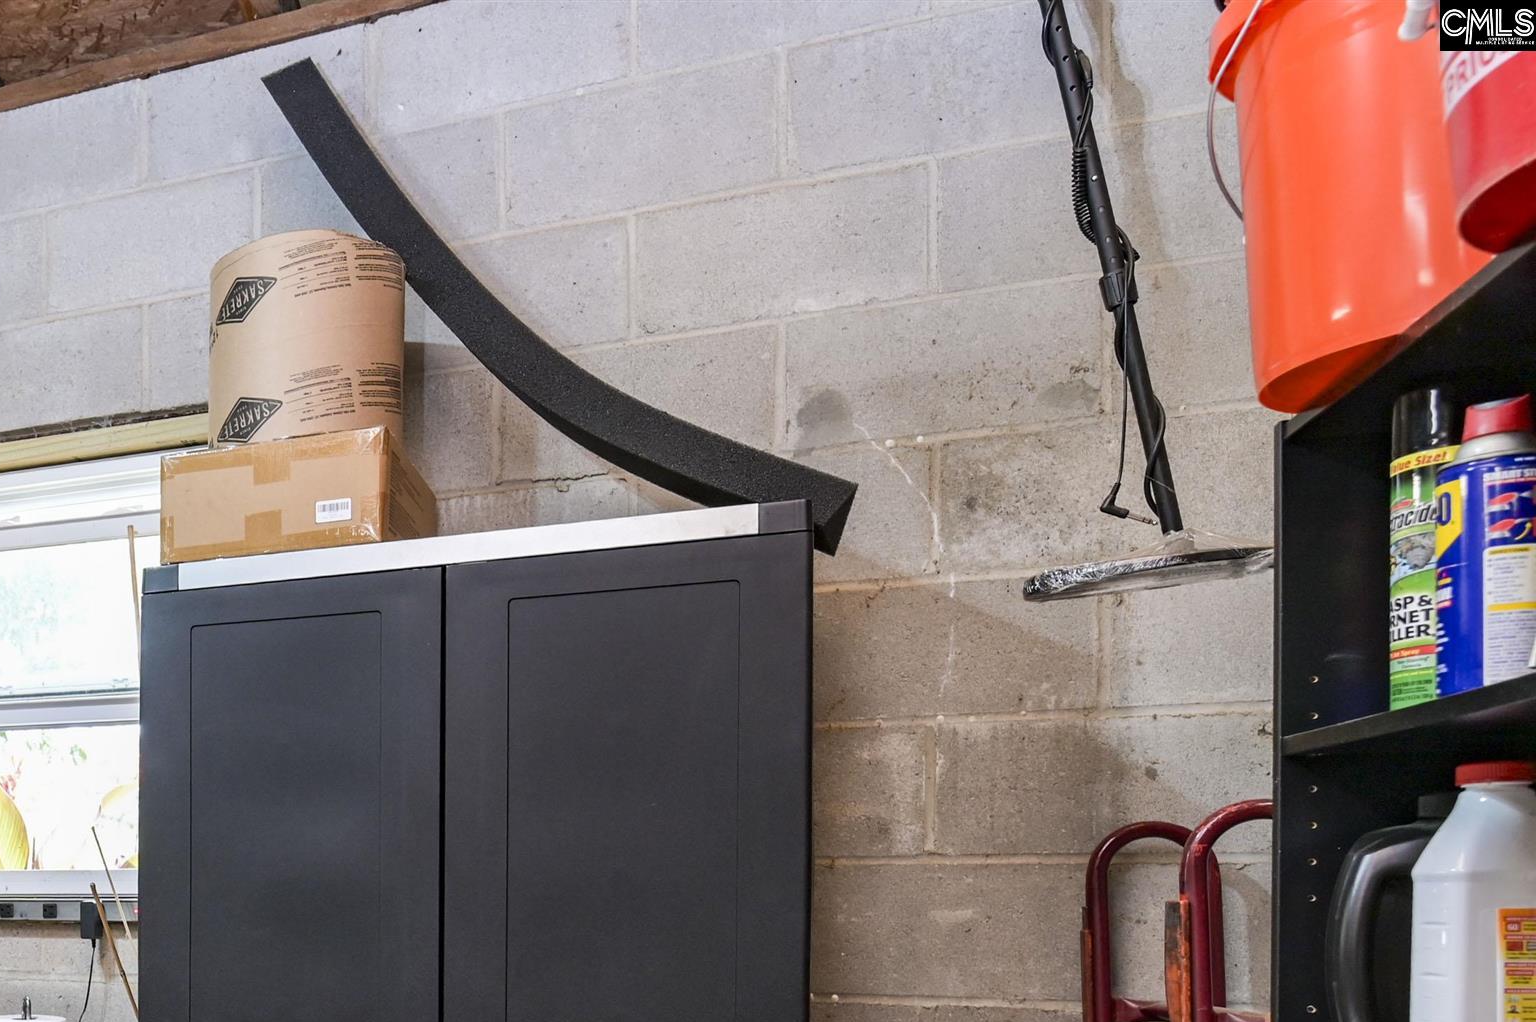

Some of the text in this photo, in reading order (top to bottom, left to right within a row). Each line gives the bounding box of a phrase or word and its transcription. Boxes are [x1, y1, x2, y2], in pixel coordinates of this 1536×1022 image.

[221, 279, 265, 321] SAKRETE
[223, 402, 272, 439] SAKRETE
[1390, 460, 1411, 474] alue
[1418, 595, 1432, 607] &
